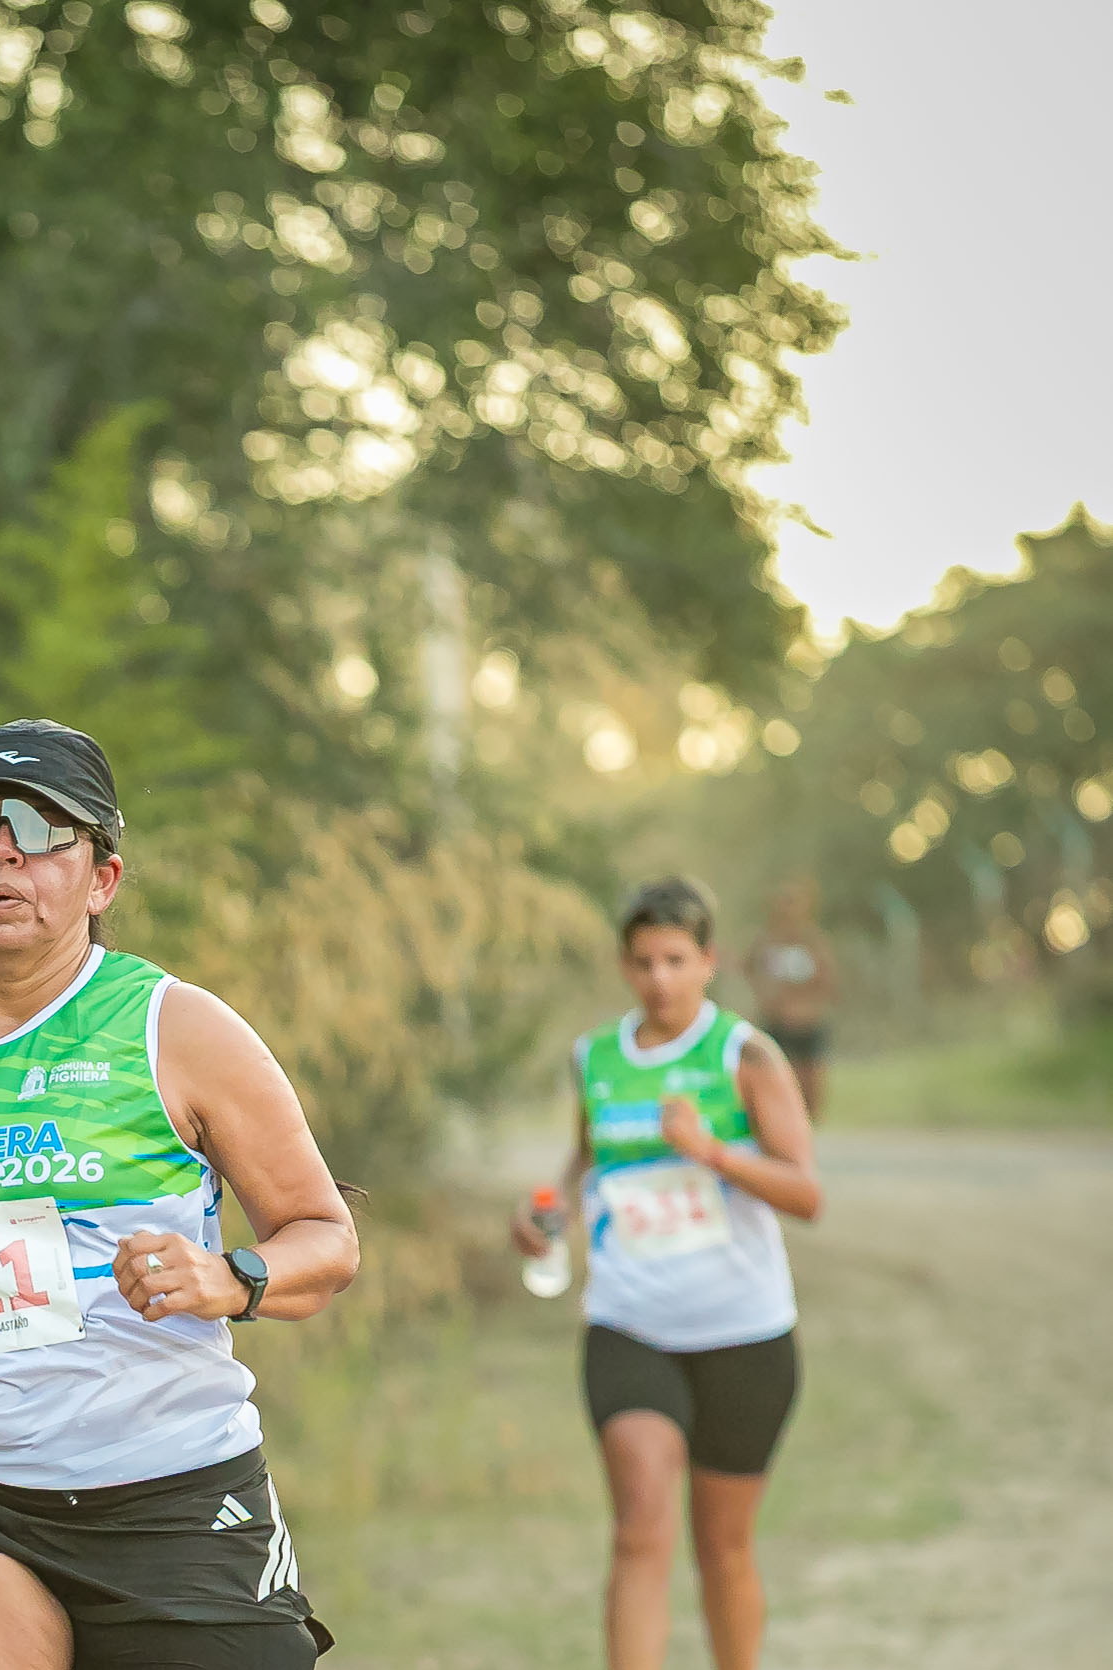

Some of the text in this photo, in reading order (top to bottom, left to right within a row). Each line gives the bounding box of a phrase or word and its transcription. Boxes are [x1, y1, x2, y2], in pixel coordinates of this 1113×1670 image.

[51, 1061, 111, 1074] COMUNA DE
[48, 1070, 109, 1084] FIGHIERA
